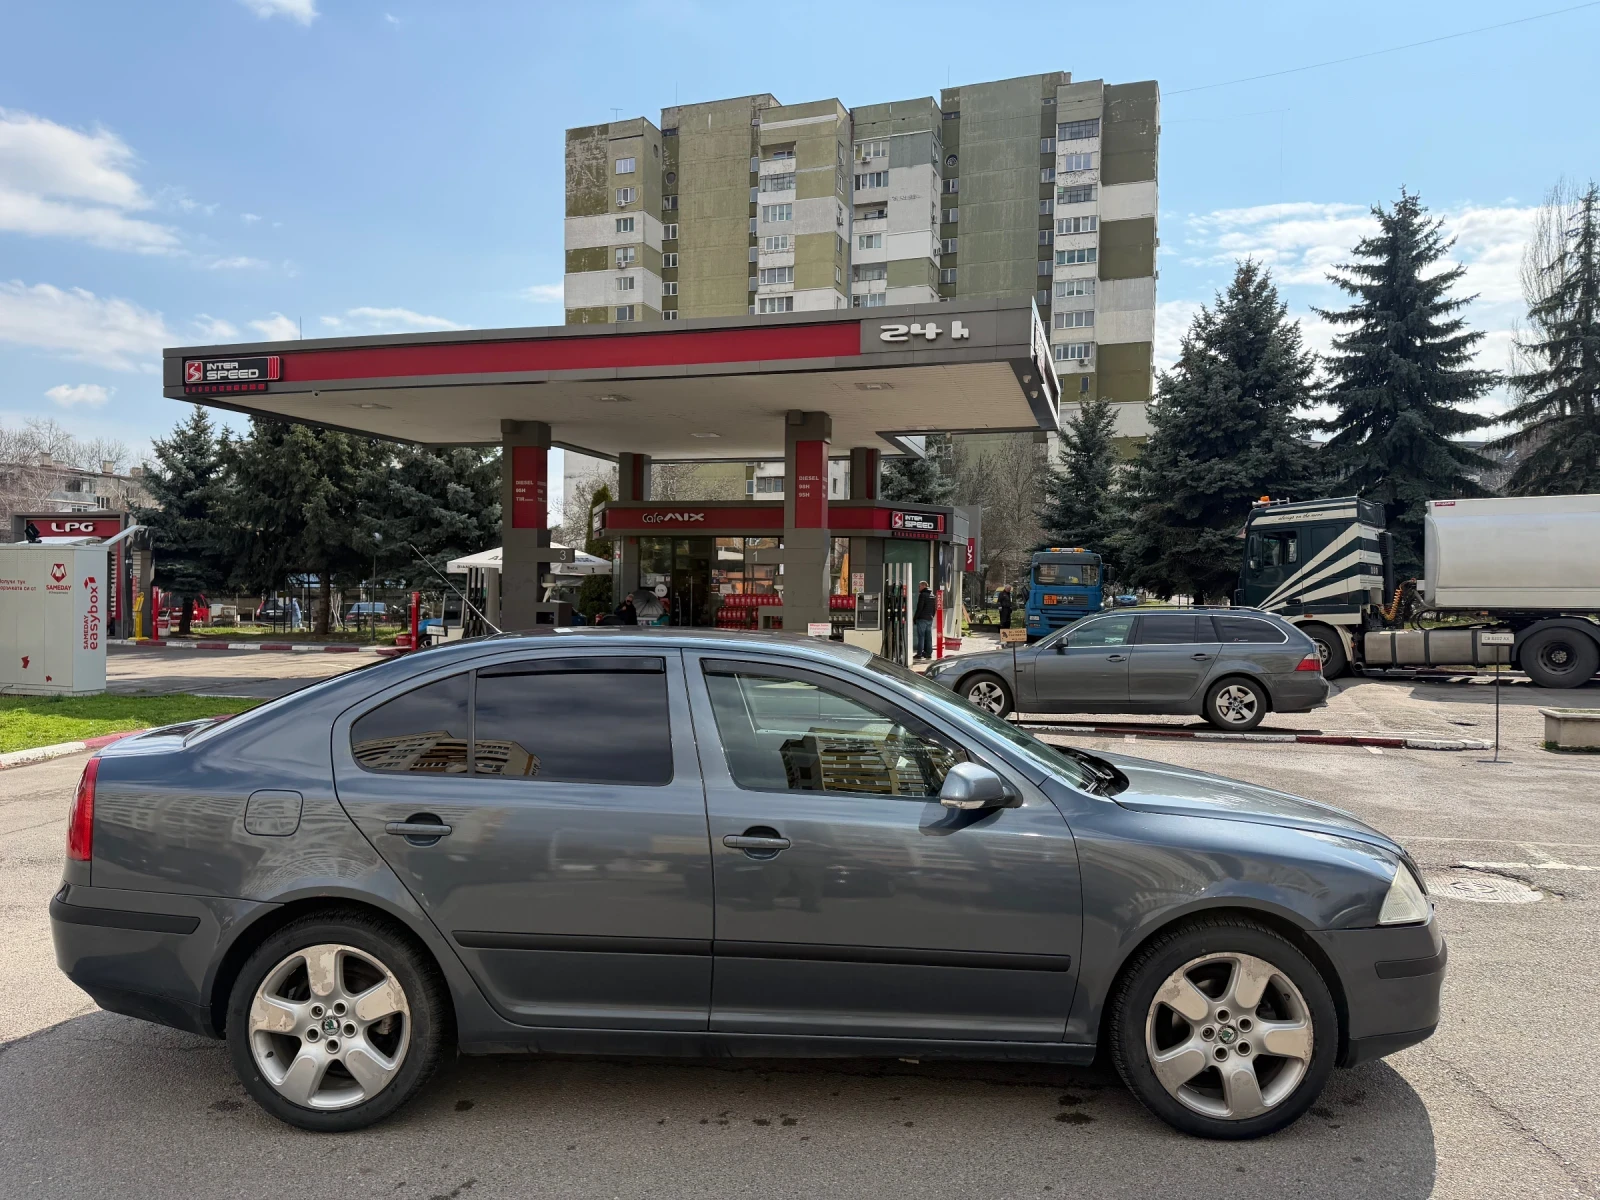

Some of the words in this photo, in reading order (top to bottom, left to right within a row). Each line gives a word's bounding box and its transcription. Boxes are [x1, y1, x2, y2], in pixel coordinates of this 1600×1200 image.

[880, 322, 943, 341] 24
[206, 362, 239, 370] INTER
[206, 369, 259, 380] SPEED
[51, 522, 94, 532] LPG
[904, 521, 934, 529] SPEED
[559, 550, 567, 560] 3
[752, 550, 758, 562] 1
[967, 545, 973, 564] WC
[87, 586, 100, 650] easybox
